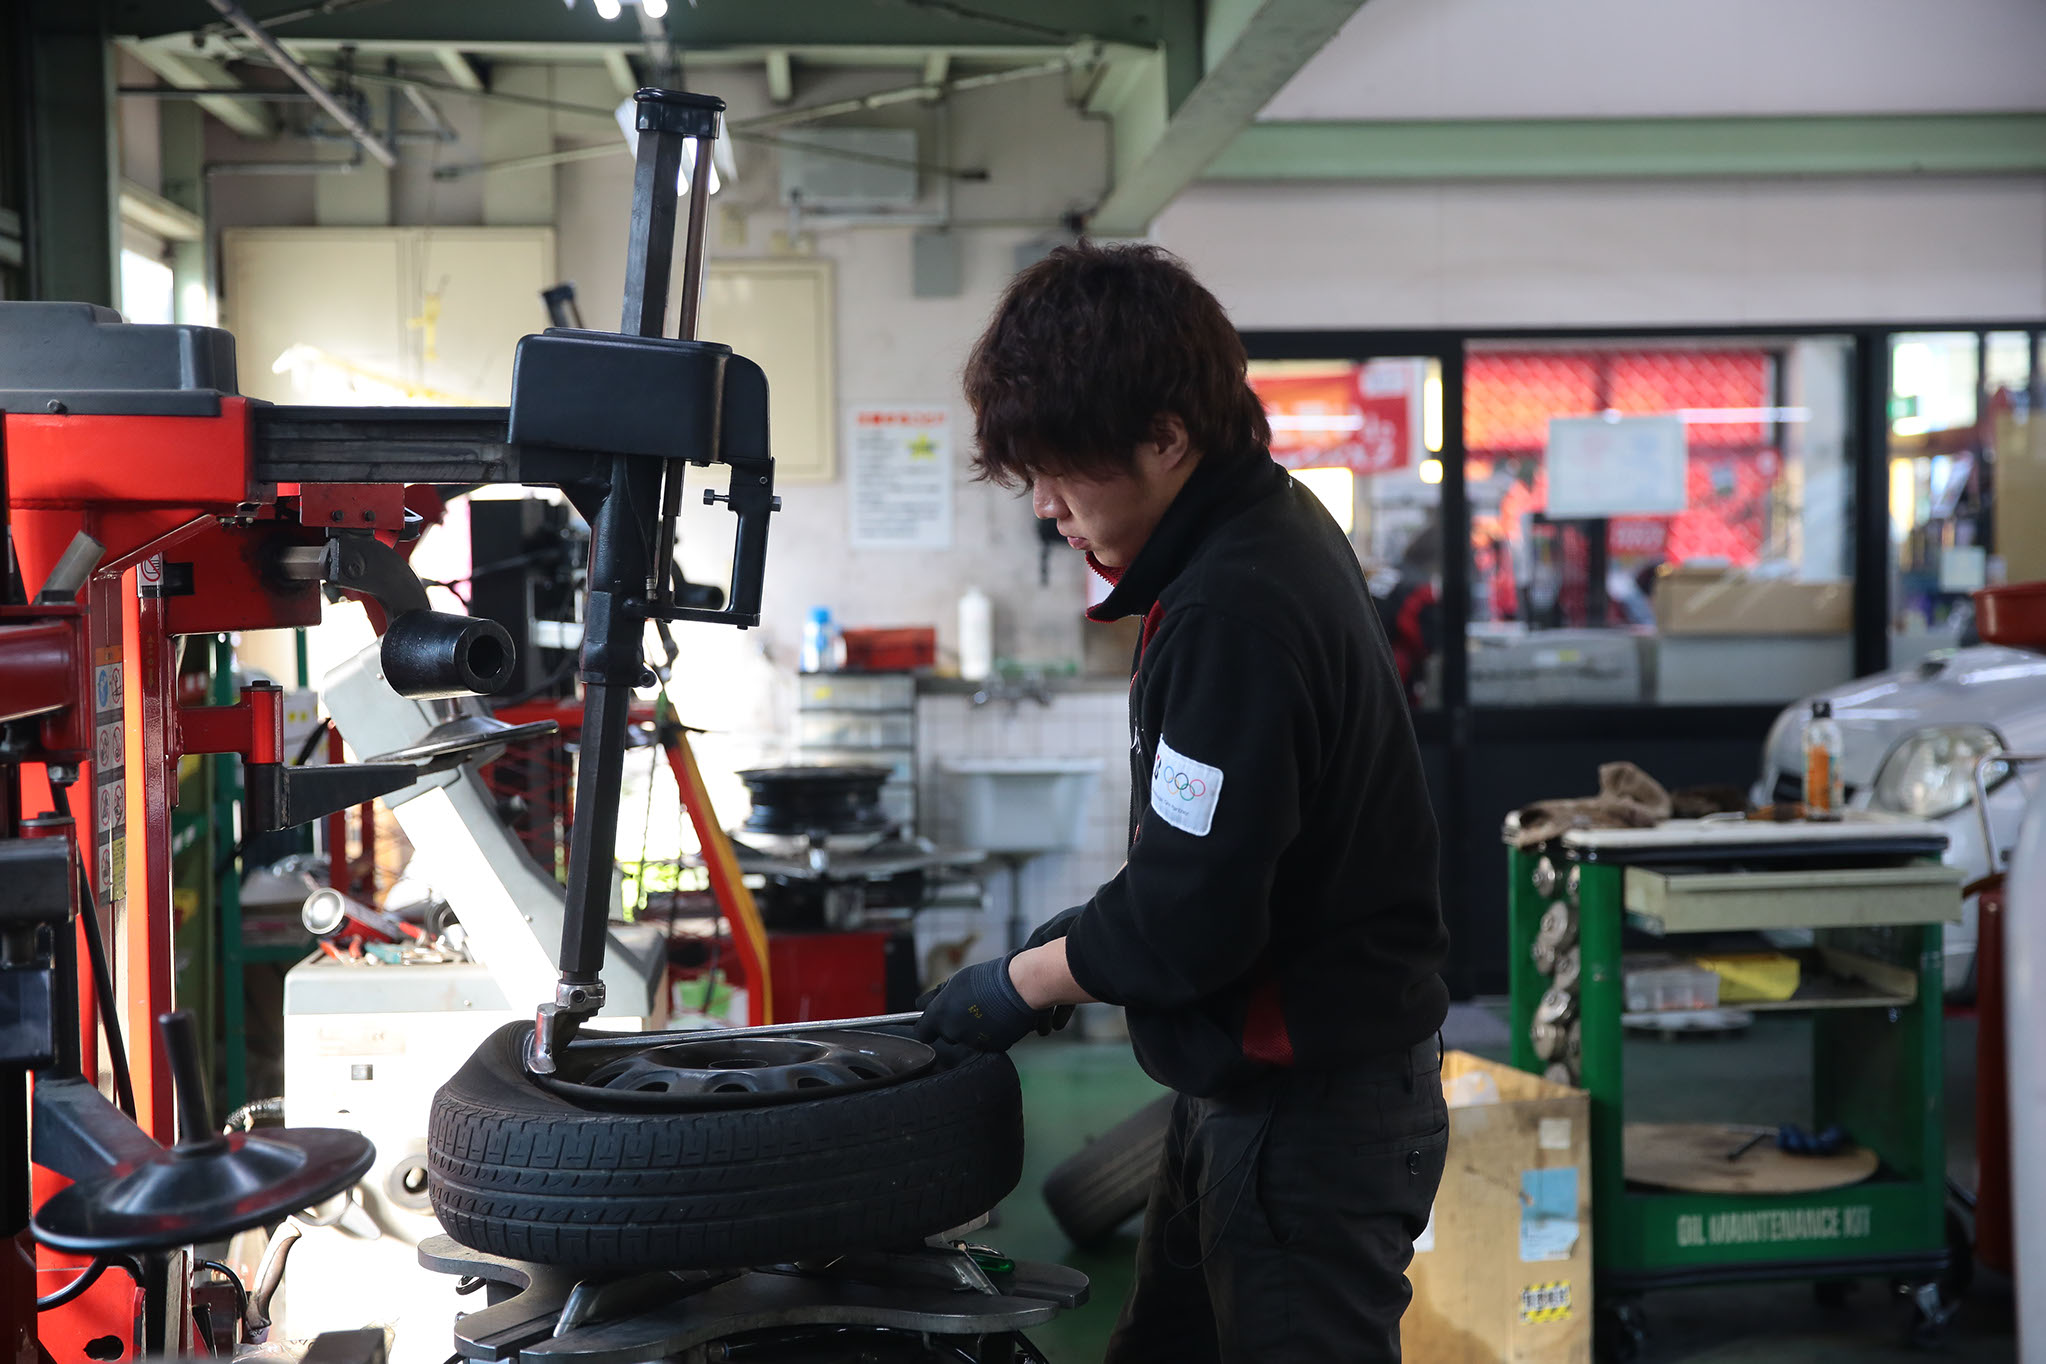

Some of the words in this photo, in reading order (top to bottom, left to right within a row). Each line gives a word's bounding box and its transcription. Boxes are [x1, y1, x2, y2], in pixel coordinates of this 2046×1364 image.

[1677, 1213, 1706, 1247] OIL
[1708, 1207, 1841, 1244] MAINTENANCE
[1842, 1205, 1871, 1238] KIT
